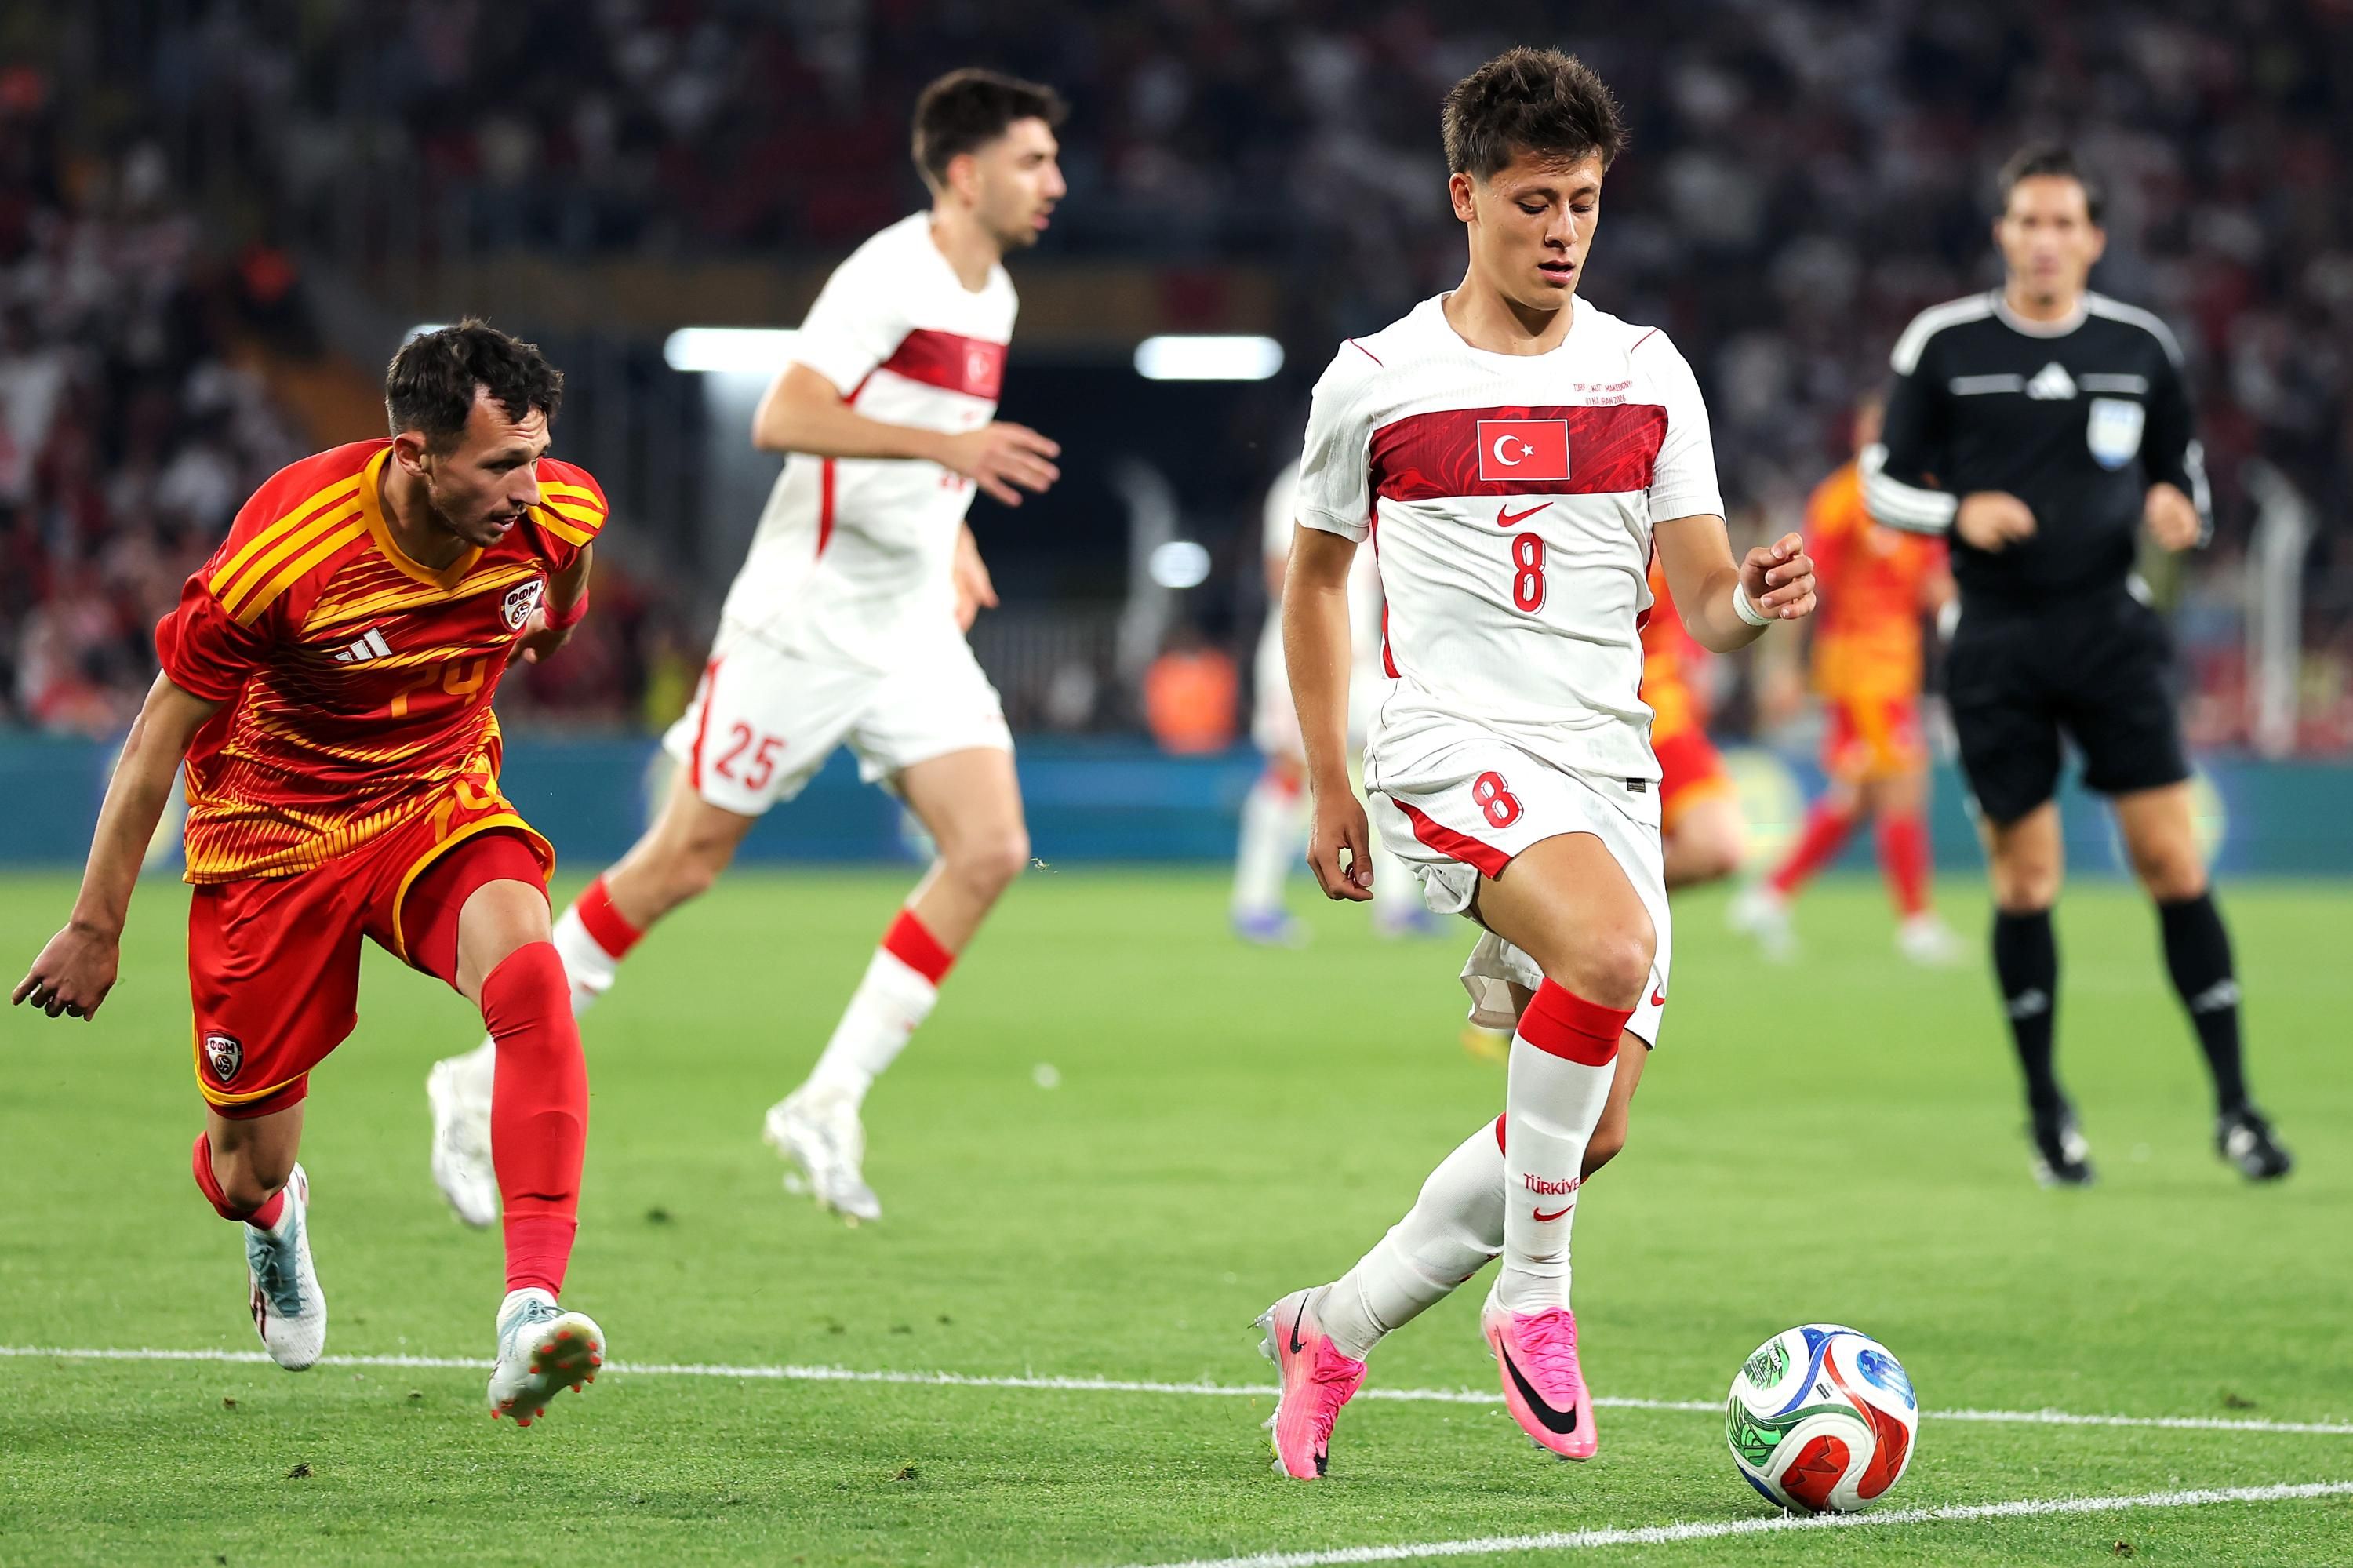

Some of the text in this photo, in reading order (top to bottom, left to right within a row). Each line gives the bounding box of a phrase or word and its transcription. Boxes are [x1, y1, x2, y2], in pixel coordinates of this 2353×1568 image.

[1512, 532, 1547, 615] 8
[715, 722, 787, 791] 25
[1472, 771, 1524, 828] 8
[1523, 1173, 1580, 1195] TÜRKİYE
